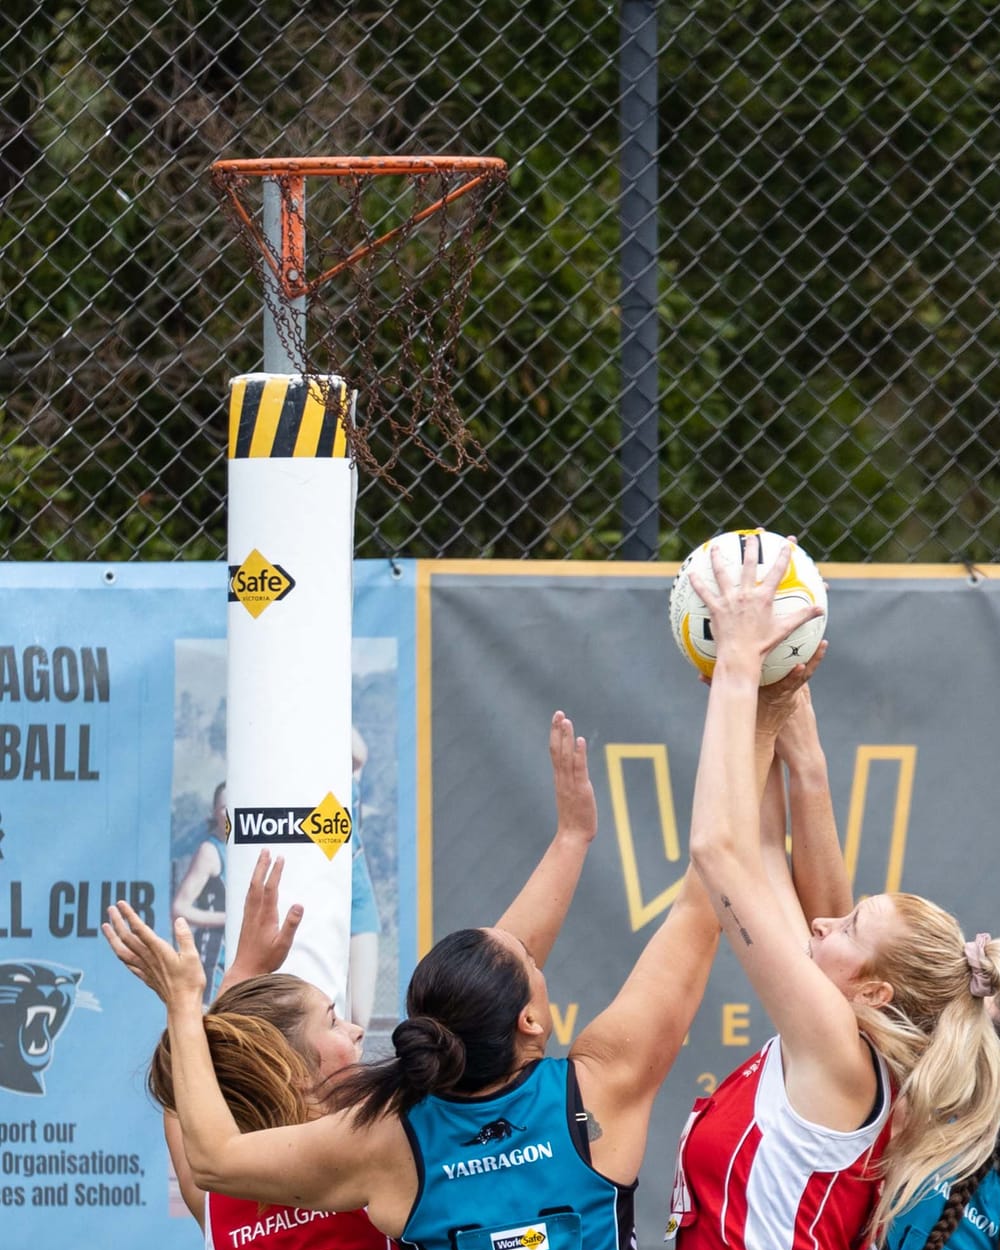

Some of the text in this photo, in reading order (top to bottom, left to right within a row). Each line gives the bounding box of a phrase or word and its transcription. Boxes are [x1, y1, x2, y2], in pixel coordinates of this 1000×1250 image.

[231, 569, 282, 593] Safe
[0, 645, 110, 703] AGON
[0, 724, 100, 781] BALL
[49, 881, 155, 938] CLUB
[43, 1122, 77, 1144] our
[2, 1150, 145, 1178] Organisations,
[443, 1141, 553, 1180] YARRAGON
[32, 1183, 68, 1207] and
[75, 1182, 147, 1207] School.
